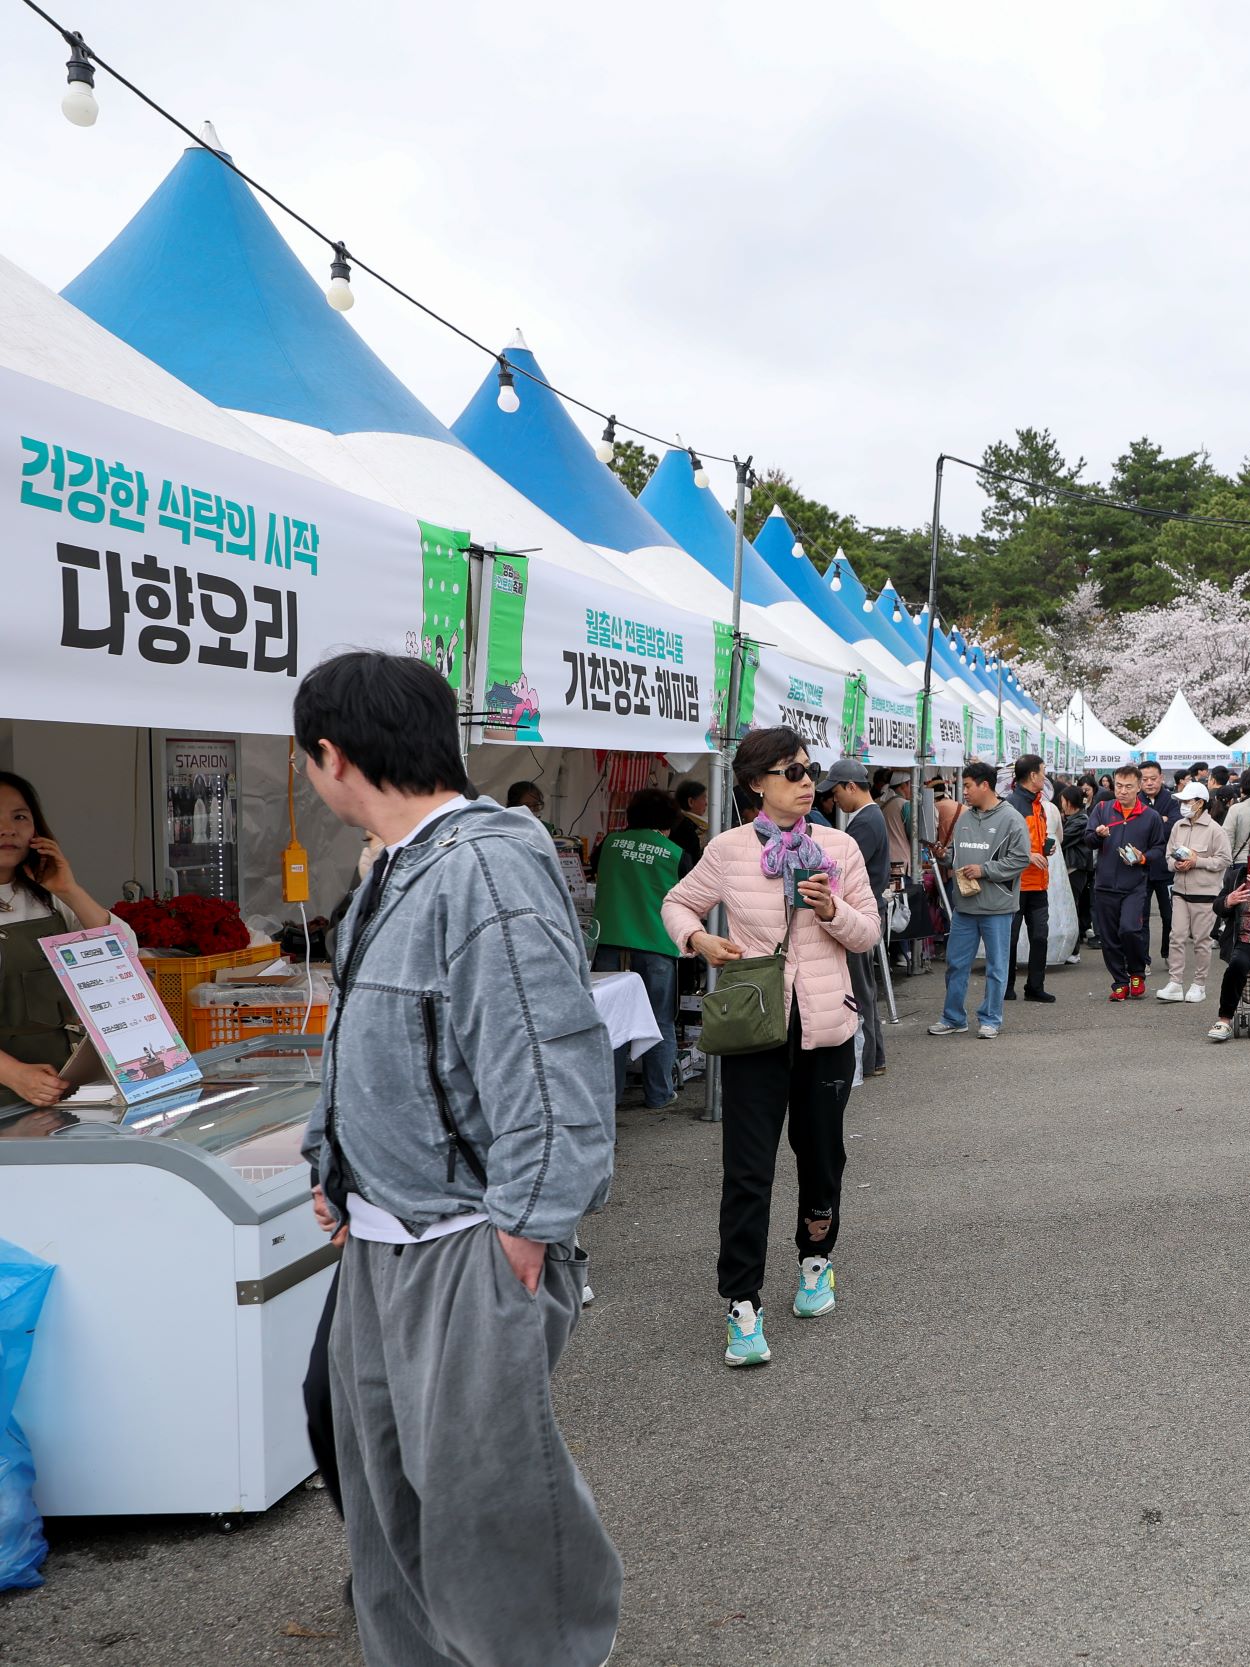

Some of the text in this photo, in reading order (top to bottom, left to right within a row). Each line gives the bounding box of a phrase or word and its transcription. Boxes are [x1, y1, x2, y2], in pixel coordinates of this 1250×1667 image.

[20, 435, 319, 577] 건강한 식탁의 시작
[56, 541, 298, 678] 다향오리
[586, 608, 684, 665] 월출산 전통발효식품
[175, 754, 228, 768] STARION
[611, 839, 671, 858] 고향을 생각하는
[622, 849, 655, 865] 주부모임
